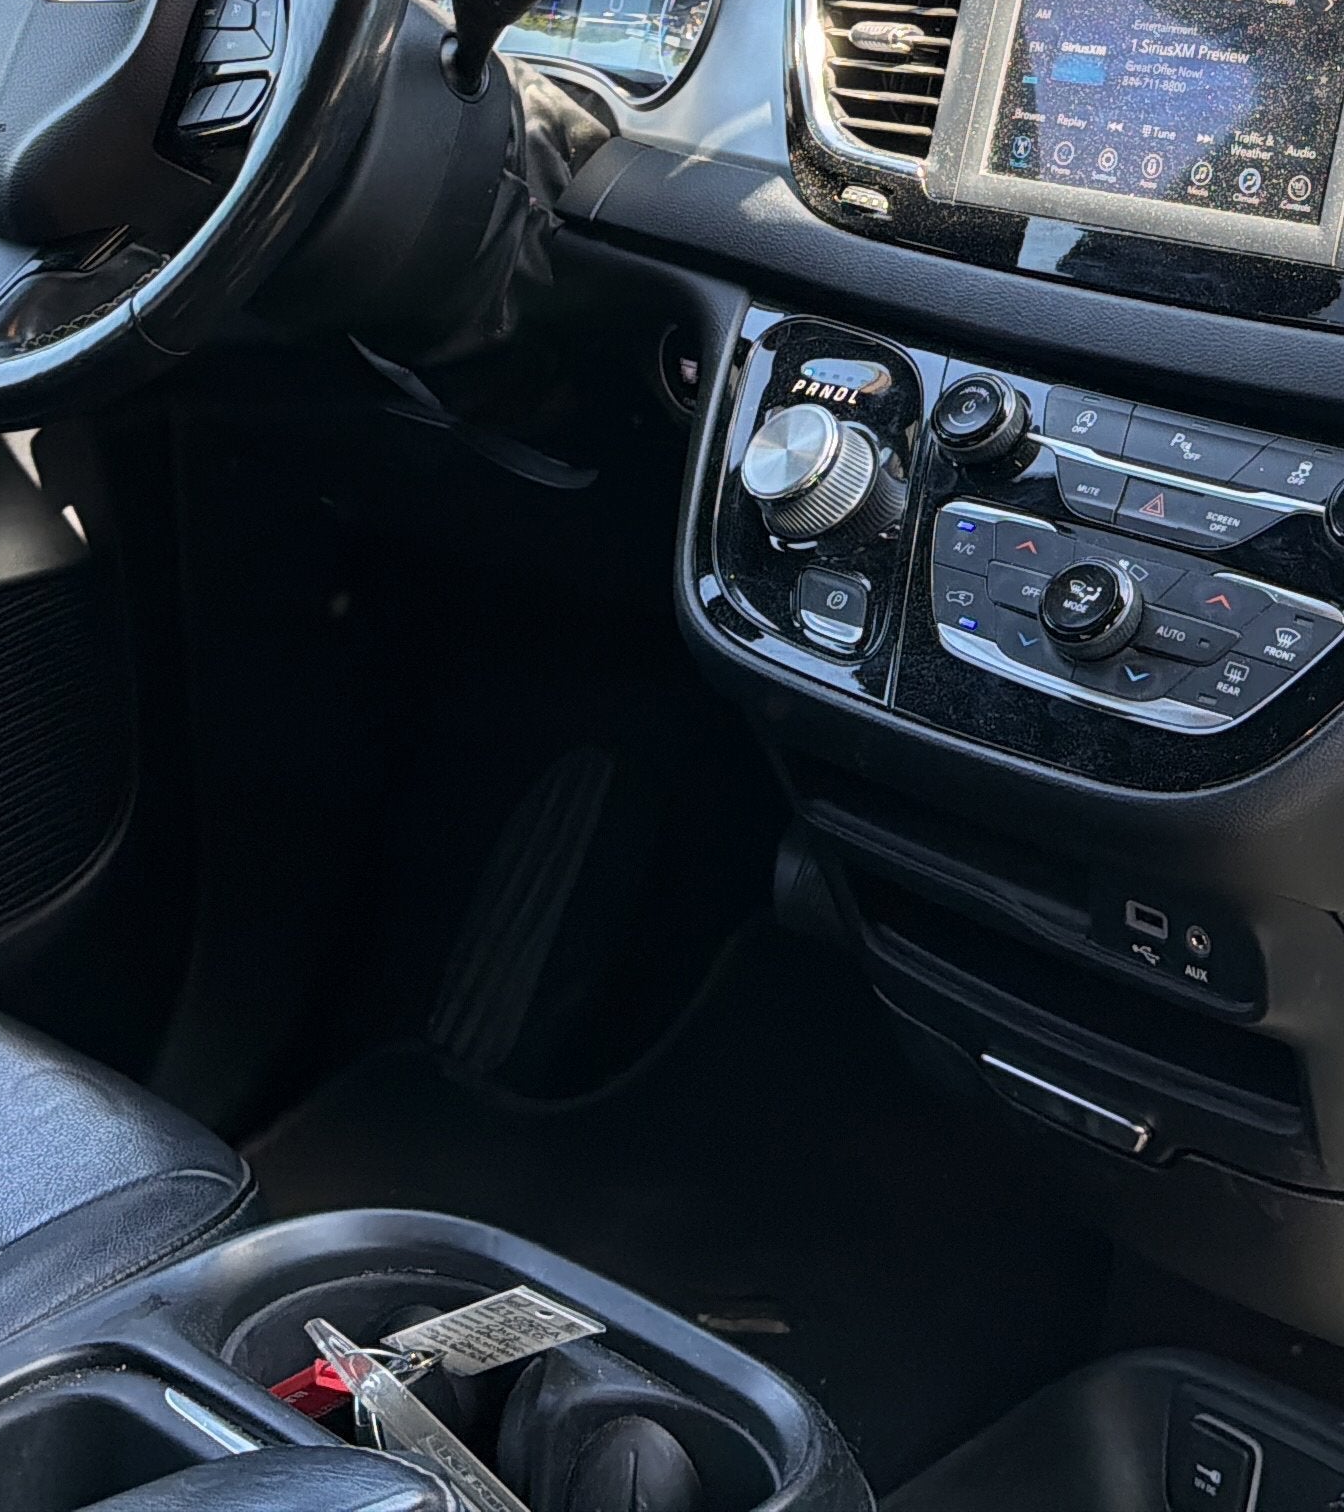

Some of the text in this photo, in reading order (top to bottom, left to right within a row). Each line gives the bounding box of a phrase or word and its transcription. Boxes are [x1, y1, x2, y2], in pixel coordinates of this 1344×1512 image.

[1035, 9, 1052, 20] AM
[1141, 40, 1195, 59] SiriusXM
[1198, 45, 1251, 65] Preview
[1014, 109, 1046, 123] Browse
[1057, 113, 1087, 130] Replay
[1153, 126, 1177, 140] Tune
[1234, 130, 1265, 146] Traffic
[1230, 144, 1274, 161] Weather
[1285, 145, 1317, 160] Audio
[1071, 425, 1089, 435] OFF
[1183, 452, 1202, 461] OFF
[1286, 475, 1306, 486] OFF
[1076, 484, 1101, 497] MUTE
[1205, 511, 1241, 528] SCREEN
[1209, 522, 1228, 533] OFF
[952, 541, 976, 556] A/C
[1021, 585, 1042, 598] OFF
[1062, 599, 1089, 614] MODE
[1156, 625, 1187, 642] AUTO
[1263, 645, 1297, 663] FRONT
[1216, 681, 1241, 697] REAR
[1184, 964, 1209, 983] AUX
